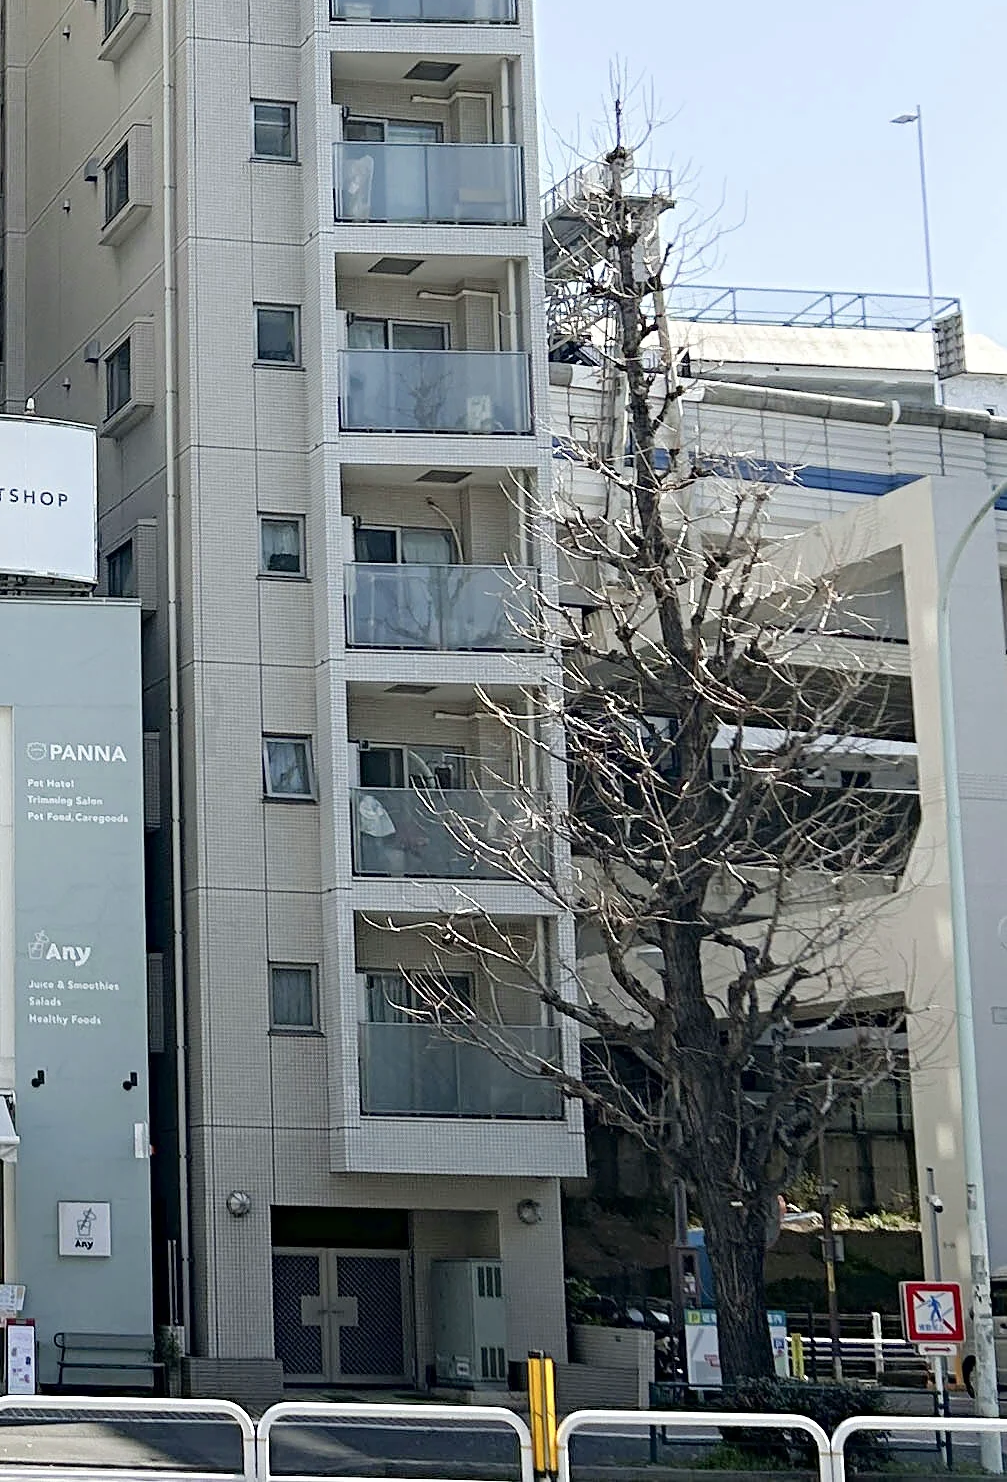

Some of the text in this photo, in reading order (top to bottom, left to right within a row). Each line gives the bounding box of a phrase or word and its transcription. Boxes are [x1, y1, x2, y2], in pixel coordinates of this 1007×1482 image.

[50, 744, 127, 762] PANNA
[27, 779, 74, 788] Pet Hotel
[27, 796, 103, 806] Trimming Salon
[45, 943, 91, 967] Any
[28, 979, 120, 991] Juice & Smoothies
[28, 997, 62, 1007] Salads
[28, 1014, 102, 1026] Healthy Foods
[74, 1239, 94, 1250] Any
